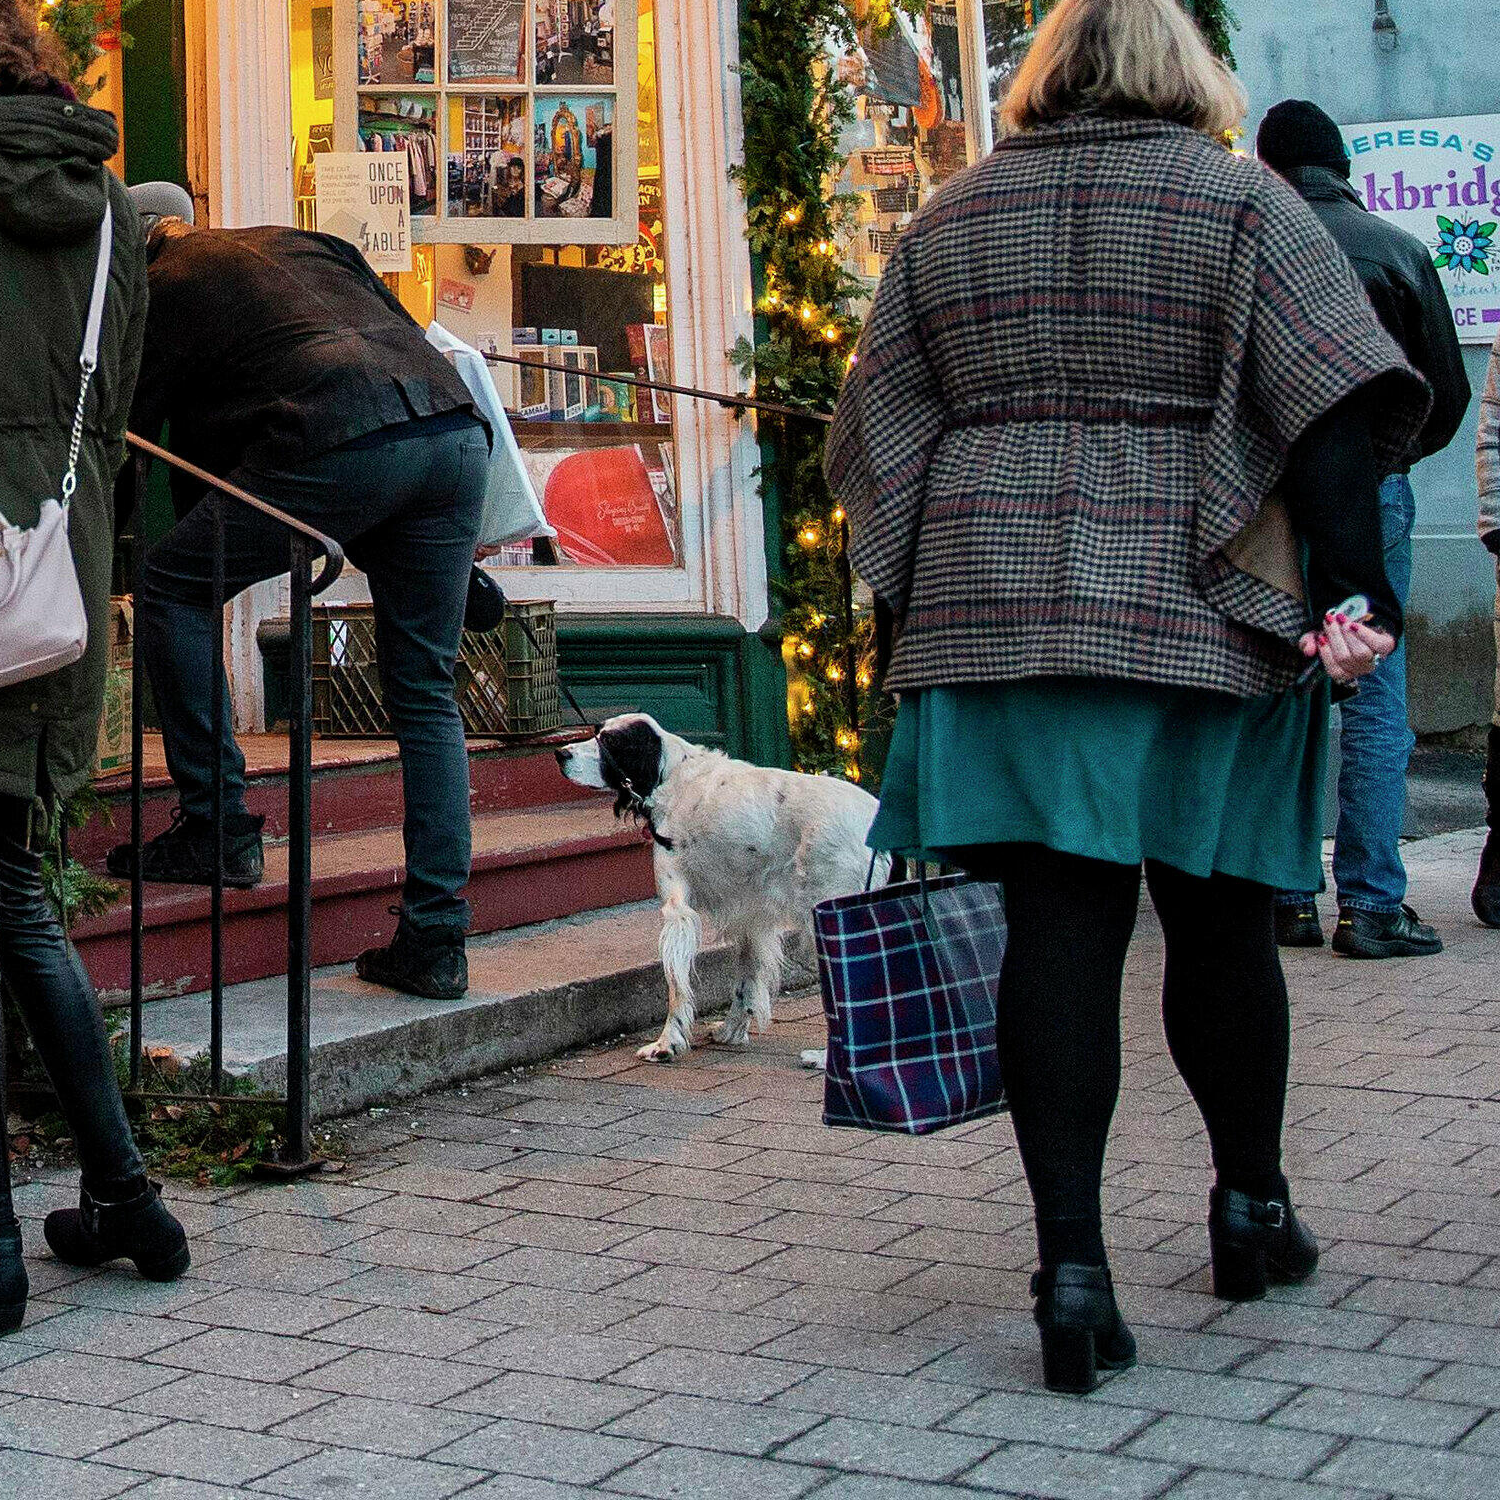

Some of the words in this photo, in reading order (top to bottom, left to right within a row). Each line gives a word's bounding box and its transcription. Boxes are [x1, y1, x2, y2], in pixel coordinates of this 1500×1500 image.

[1345, 129, 1494, 162] ERESA'S
[369, 162, 403, 182] ONCE
[369, 185, 404, 205] UPON
[1356, 165, 1500, 216] kbridg
[398, 209, 405, 228] A
[364, 232, 406, 252] TABLE
